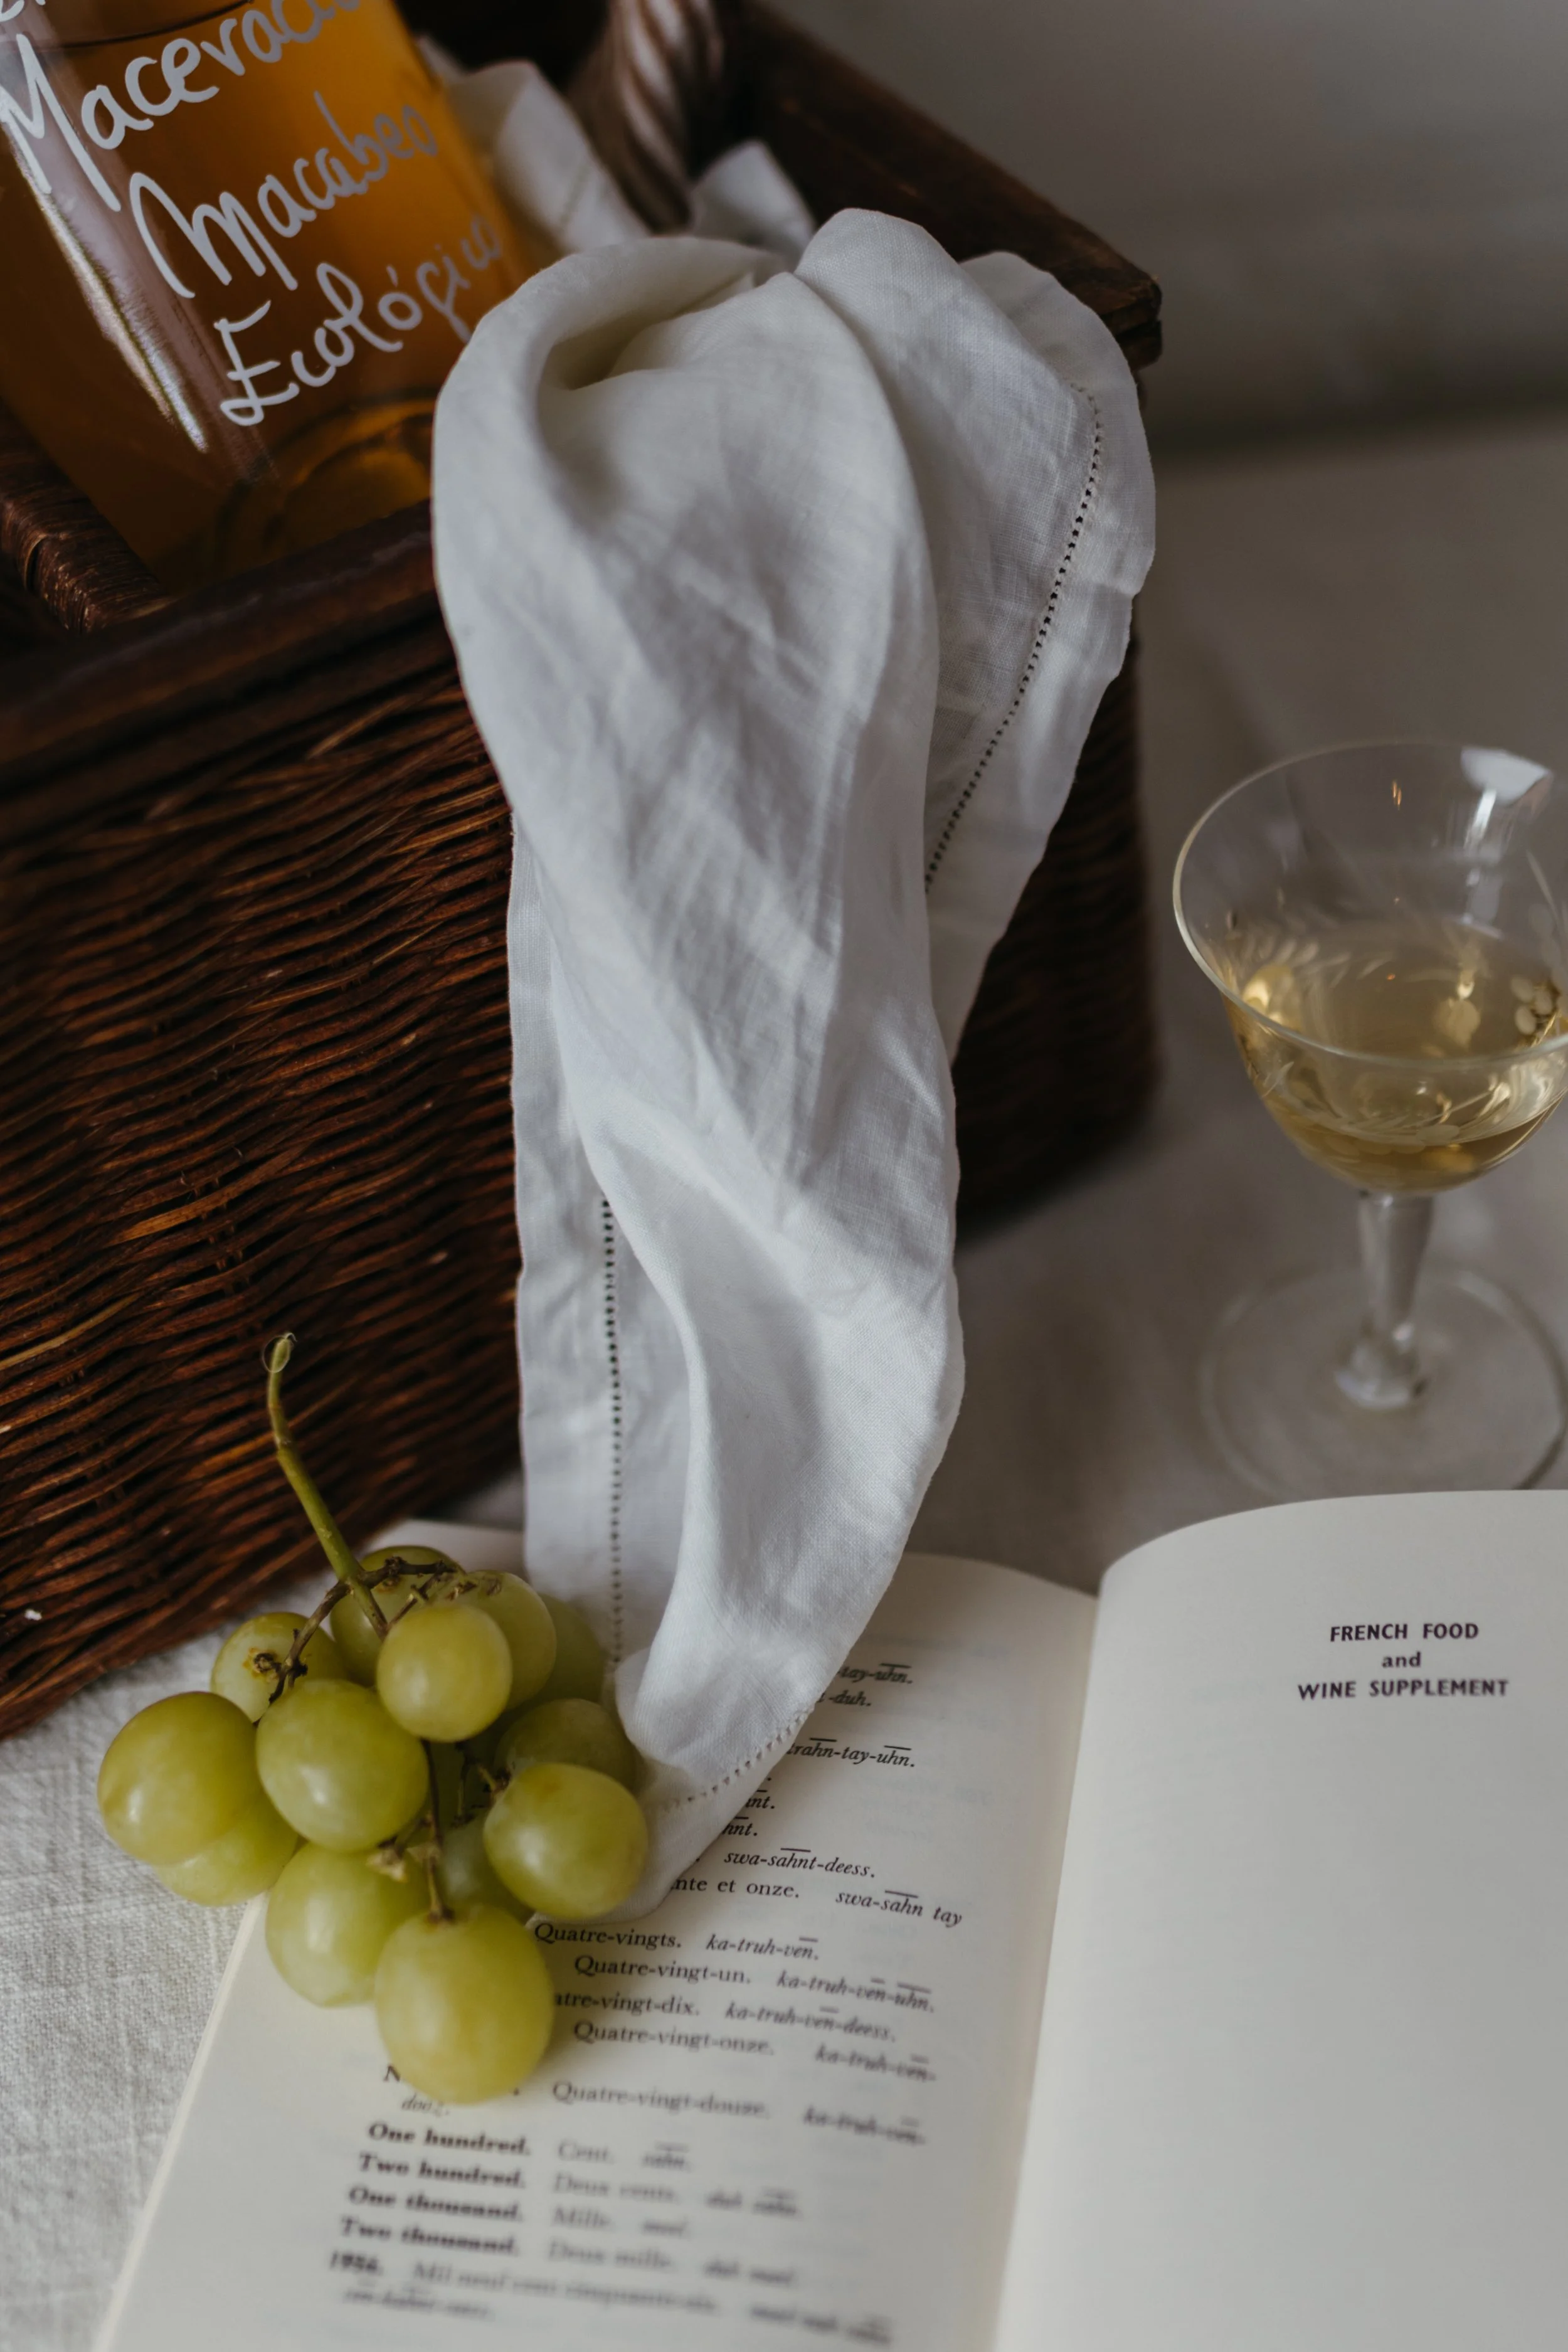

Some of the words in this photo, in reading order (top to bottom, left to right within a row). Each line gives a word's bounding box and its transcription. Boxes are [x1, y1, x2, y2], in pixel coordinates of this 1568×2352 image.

[129, 90, 438, 299] Macabeo
[1330, 1623, 1408, 1642] FRENCH
[1422, 1623, 1479, 1640] FOOD
[1382, 1651, 1422, 1668] and
[1298, 1681, 1357, 1700] WINE
[1369, 1679, 1508, 1697] SUPPLEMENT
[723, 1848, 875, 1879] swa-sahnt-deess.
[717, 1879, 736, 1893] et
[746, 1883, 800, 1899] onze.
[835, 1890, 923, 1917] swa-sahn
[933, 1906, 963, 1928] tay
[534, 1922, 682, 1949] Quatre-vingts.
[706, 1934, 819, 1961] ka-truh-ven.
[574, 1954, 752, 1985] Quatre-vingt-un.
[776, 1970, 935, 2013] ka-truh-ven-uhn.
[554, 1990, 701, 2017] atre-vingt-dix.
[724, 2001, 896, 2043] ka-truh-ven-deess.
[573, 2021, 775, 2056] Quatre-vingt-onze.
[553, 2080, 770, 2119] Quatre-vingt-douze.
[368, 2122, 415, 2145] One
[424, 2129, 531, 2156] hundred.
[359, 2152, 409, 2176] Two
[418, 2160, 526, 2188] hundred.
[349, 2186, 396, 2209] One
[405, 2193, 523, 2223] thousand.
[341, 2217, 391, 2241] Two
[400, 2226, 520, 2257] thousand.
